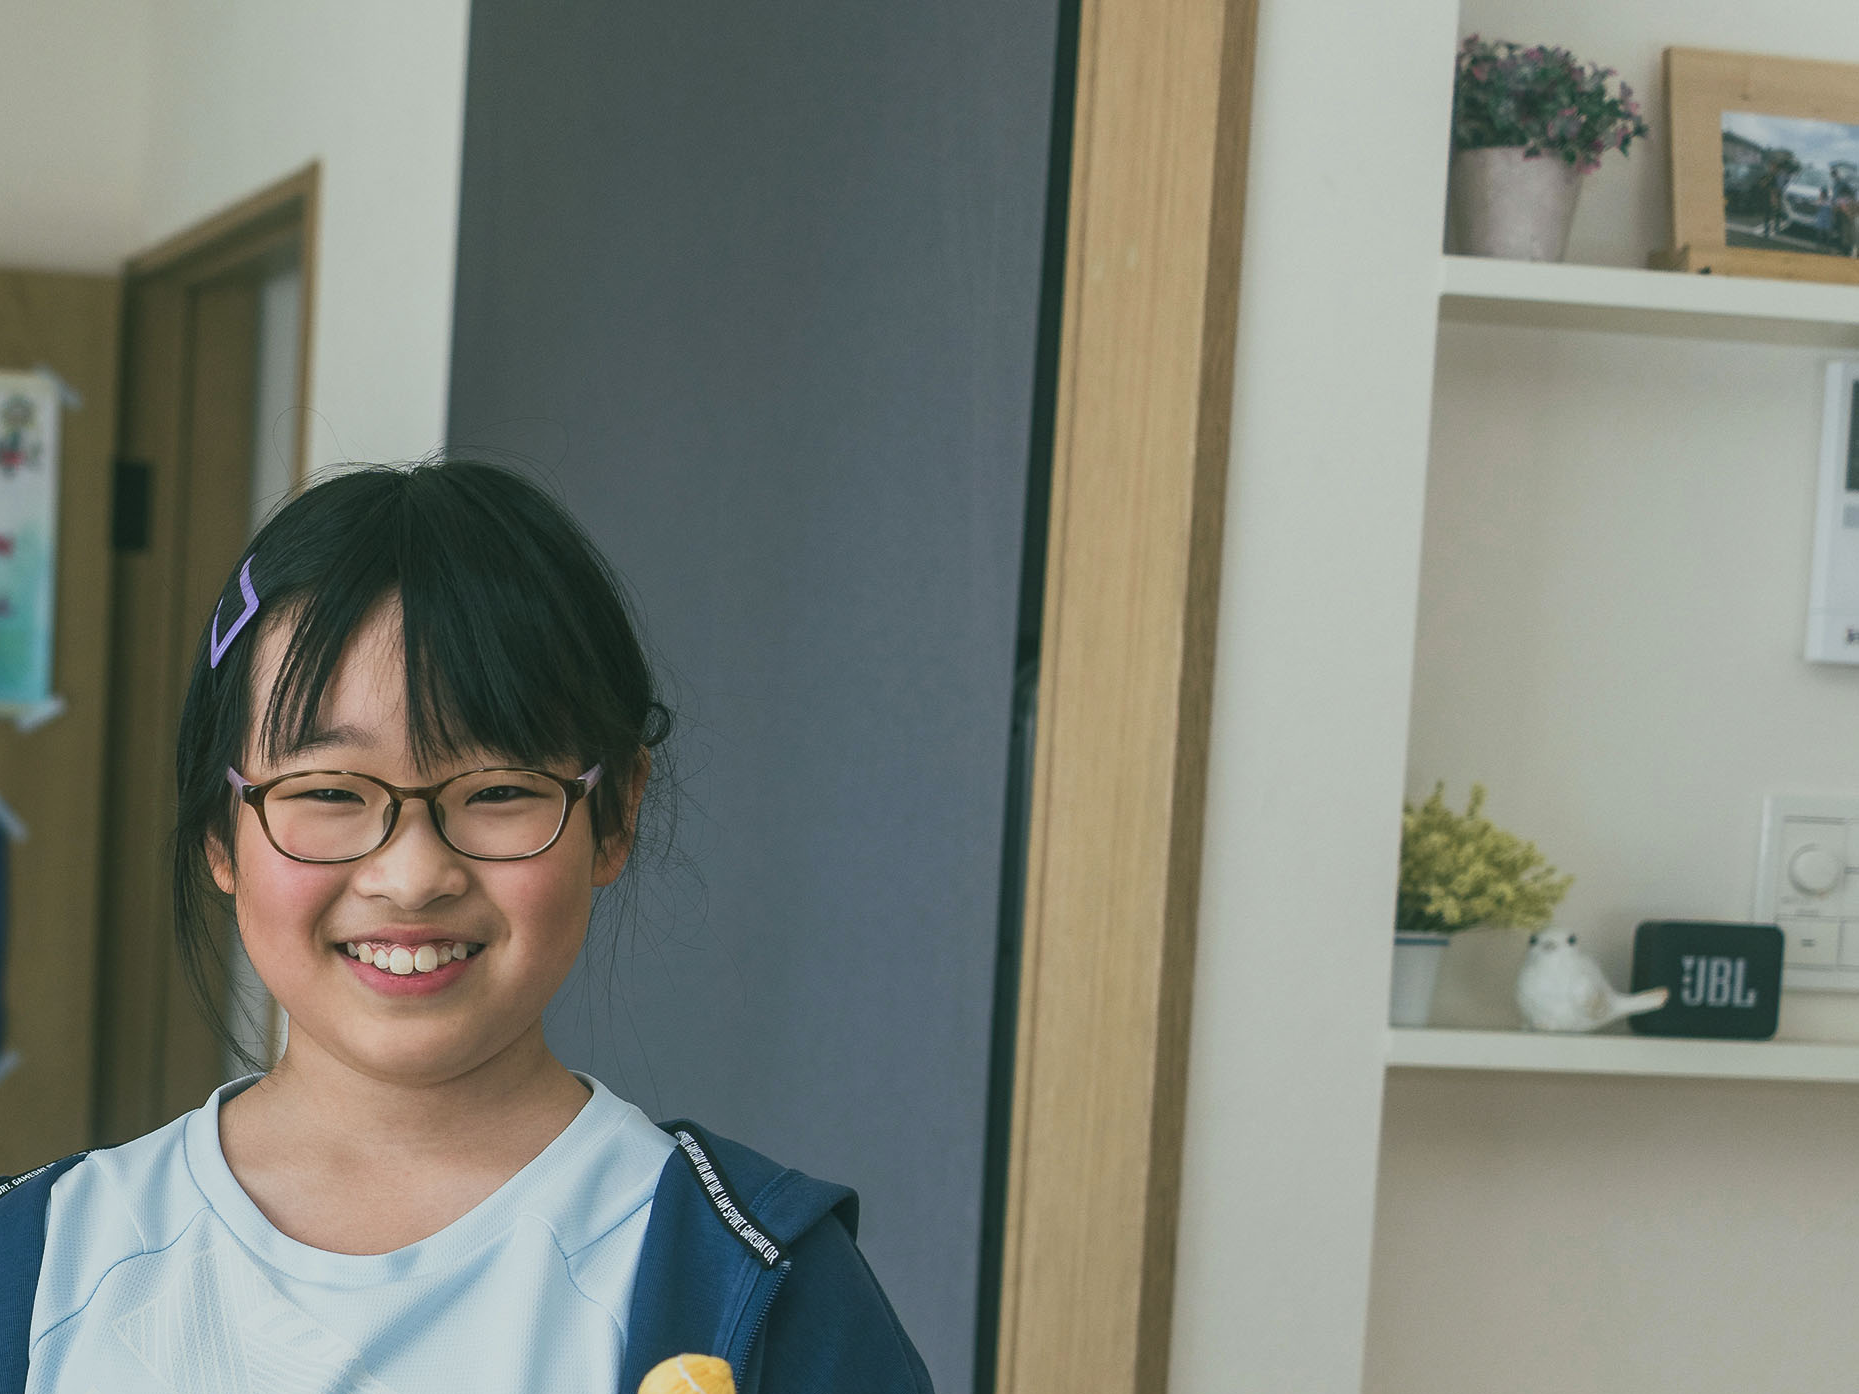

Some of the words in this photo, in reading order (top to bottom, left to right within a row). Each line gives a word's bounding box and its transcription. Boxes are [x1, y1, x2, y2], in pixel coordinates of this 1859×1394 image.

[1681, 954, 1757, 1007] JBL
[696, 1162, 712, 1174] OR
[700, 1170, 719, 1185] ANY
[713, 1192, 727, 1202] I
[715, 1197, 733, 1212] AM
[722, 1206, 748, 1232] SPORT.
[739, 1224, 773, 1253] GAMEDAY
[763, 1246, 780, 1265] OR
